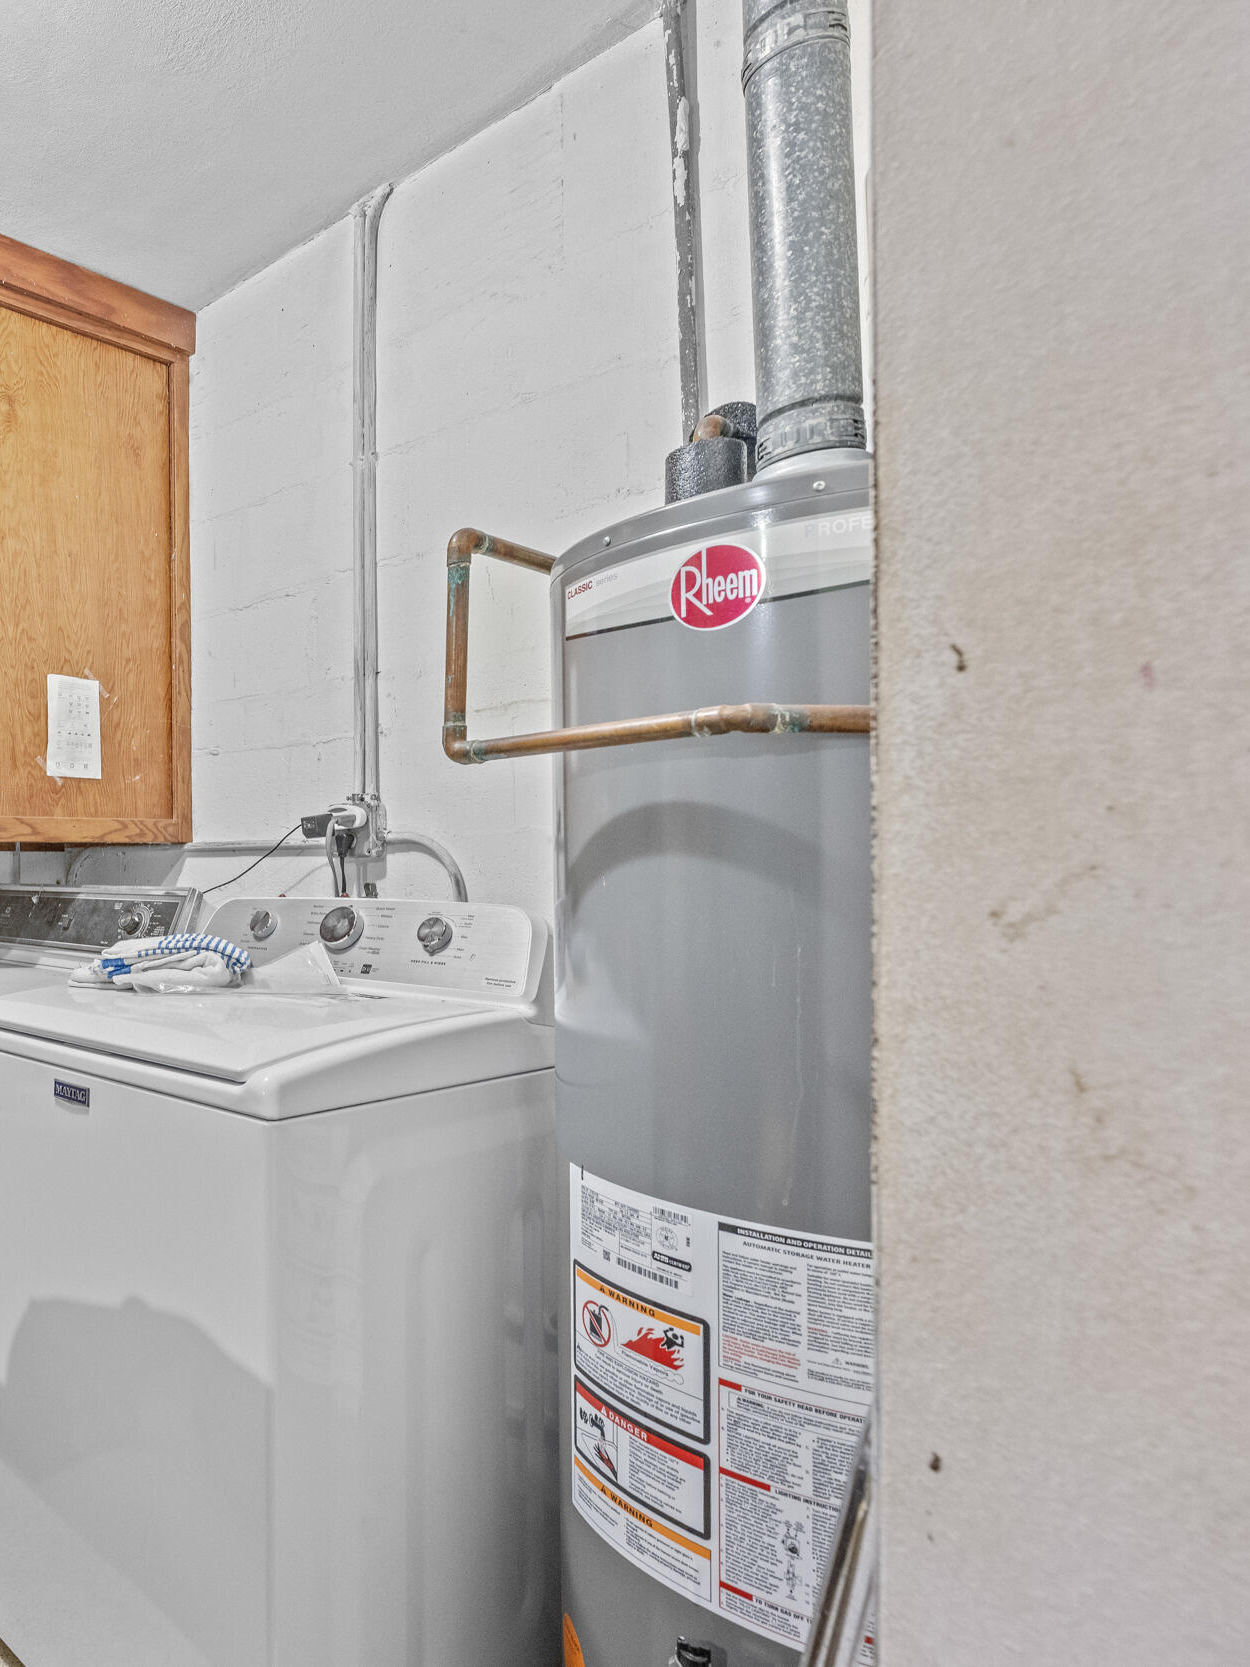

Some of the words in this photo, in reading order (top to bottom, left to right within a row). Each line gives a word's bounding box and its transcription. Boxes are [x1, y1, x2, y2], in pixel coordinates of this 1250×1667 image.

[567, 580, 593, 600] CLASSIC
[595, 573, 617, 587] series
[680, 547, 758, 618] Rheem
[54, 1083, 87, 1102] MAYTAG
[737, 1227, 786, 1245] INSTALLATION
[786, 1237, 802, 1247] AND
[803, 1240, 846, 1254] OPERATION
[742, 1240, 782, 1254] AUTOMATIC
[782, 1249, 815, 1260] STORAGE
[816, 1255, 841, 1265] WATER
[842, 1259, 871, 1269] HEATER
[608, 1289, 656, 1318] WARNING
[744, 1388, 756, 1397] FOR
[757, 1391, 773, 1402] YOUR
[774, 1395, 796, 1408] SAFETY
[797, 1403, 813, 1413] READ
[814, 1407, 838, 1419] BEFORE
[609, 1410, 648, 1442] DANGER
[610, 1492, 653, 1528] WARNING
[774, 1489, 802, 1503] LIGHTING
[763, 1601, 779, 1612] TURN
[780, 1606, 792, 1617] GAS
